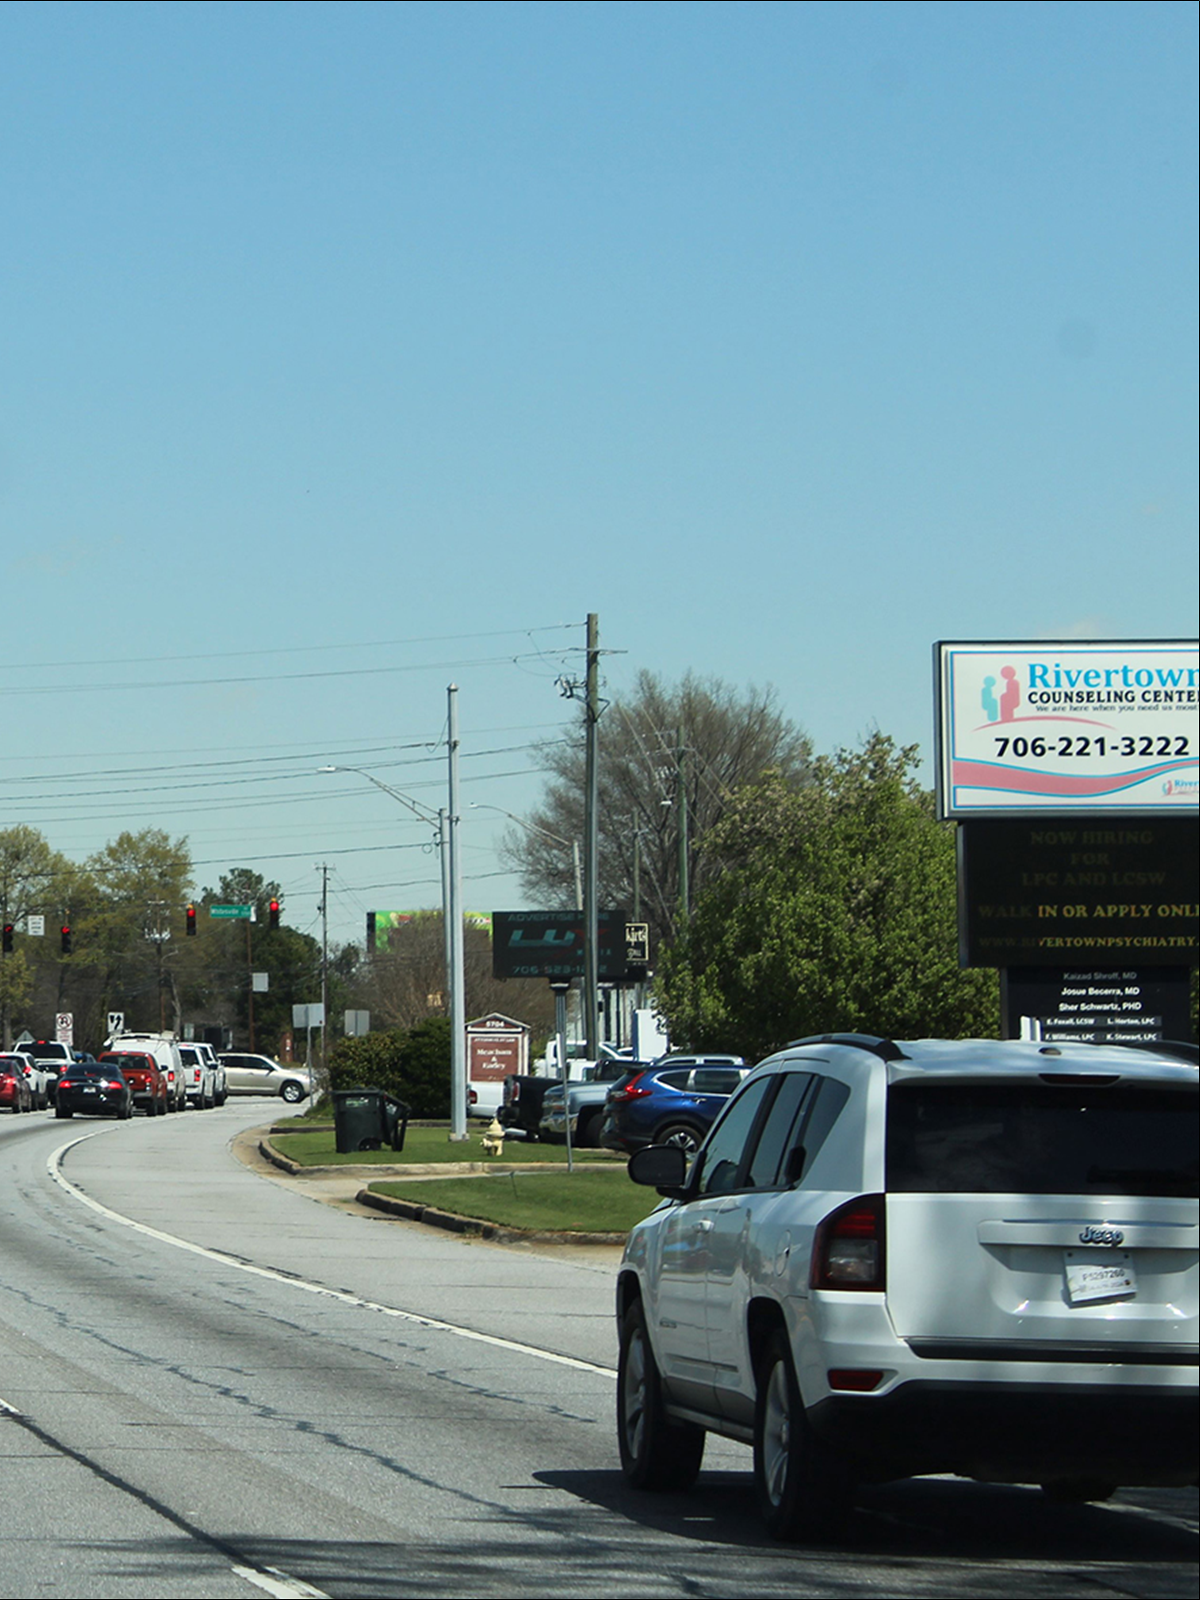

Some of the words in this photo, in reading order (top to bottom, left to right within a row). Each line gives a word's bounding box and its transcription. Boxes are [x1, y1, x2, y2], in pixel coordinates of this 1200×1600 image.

[1028, 690, 1135, 704] COUNSELING
[1141, 690, 1199, 703] CENTE
[1069, 704, 1089, 712] here
[1092, 704, 1116, 712] when
[1118, 705, 1135, 714] you
[994, 736, 1189, 757] 706-221-3222
[1030, 831, 1077, 845] NOW
[1082, 831, 1154, 845] HIRING
[1070, 852, 1111, 866] FOR
[1022, 872, 1058, 886] LPC
[1063, 872, 1106, 886] AND
[1112, 872, 1166, 886] LCSW
[508, 913, 575, 922] ADVERTISE
[978, 905, 1032, 918] WALK
[1037, 905, 1058, 918] IN
[1062, 905, 1089, 918] OR
[1092, 905, 1152, 918] APPLY
[1122, 971, 1137, 980] MD
[1061, 987, 1087, 996] Josue
[1125, 986, 1140, 996] MD
[1122, 1001, 1142, 1011] PHD
[1079, 1226, 1124, 1247] Jeep
